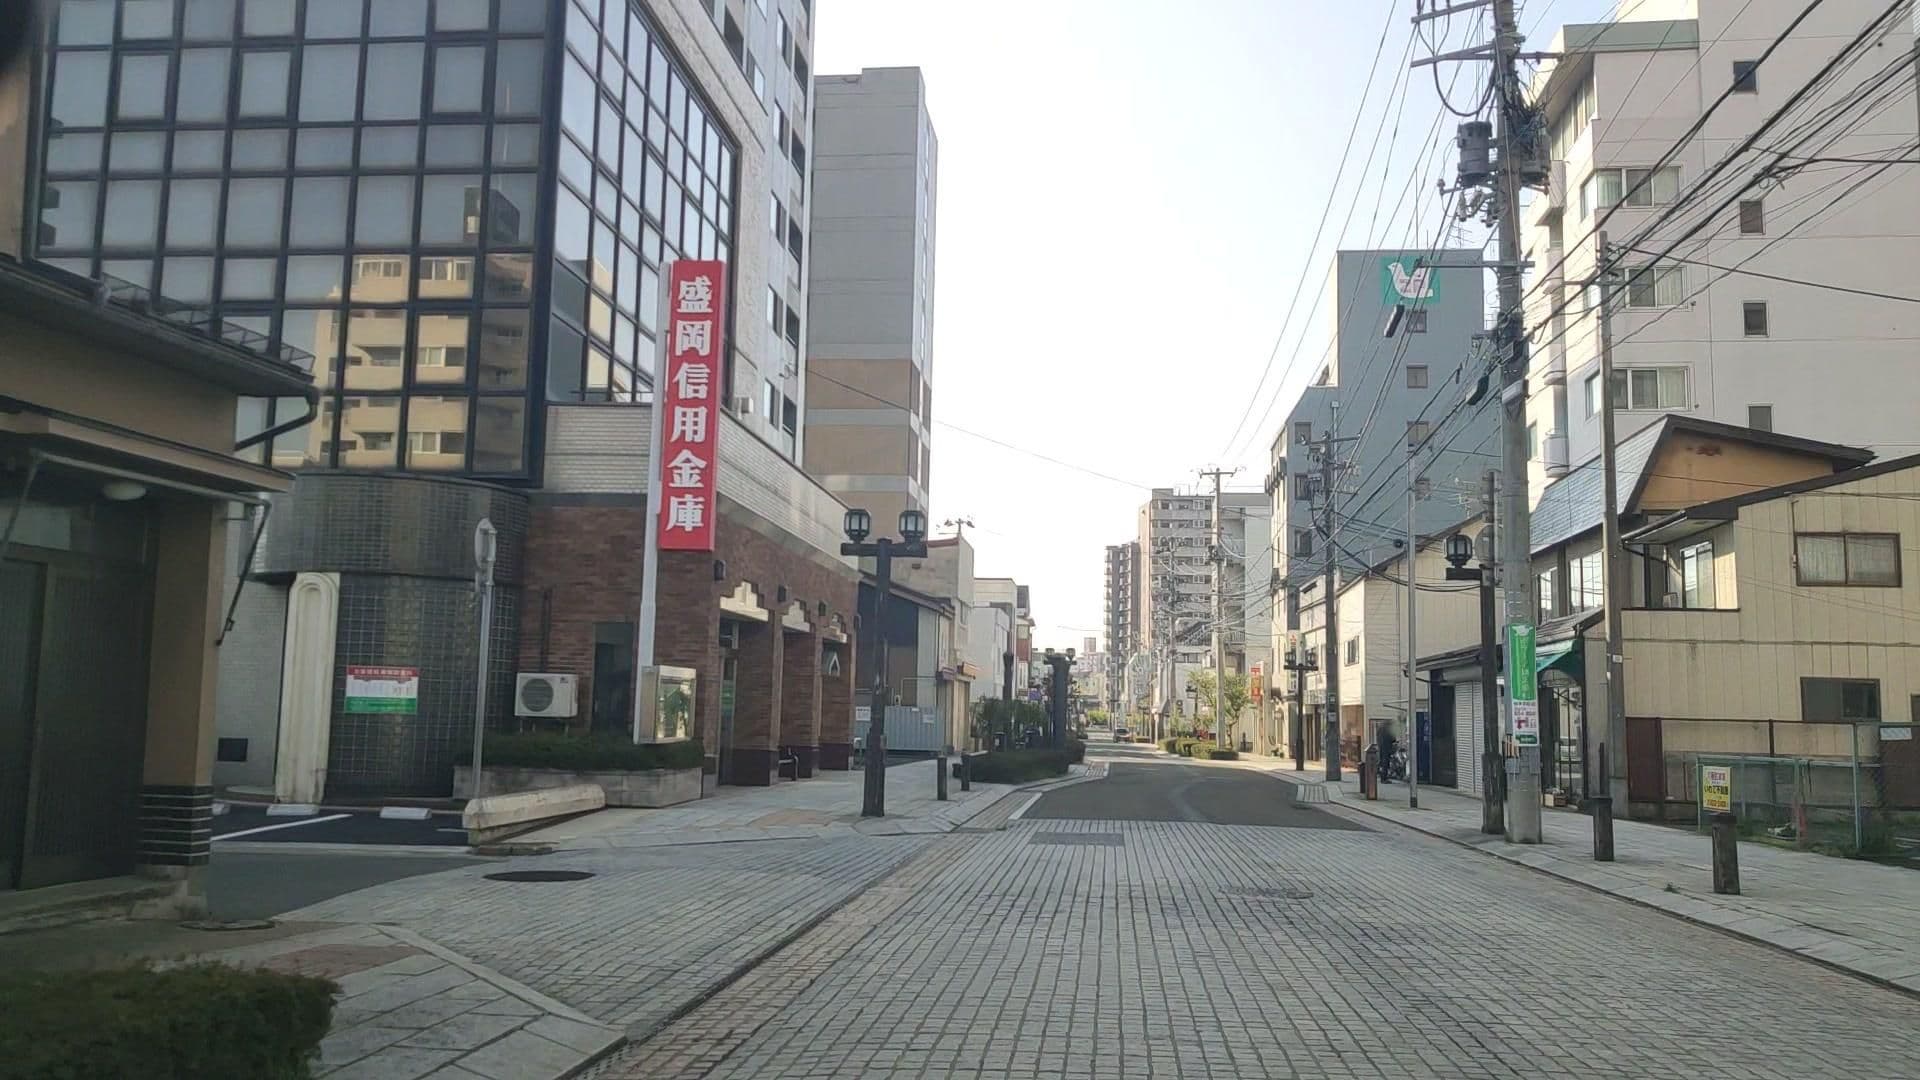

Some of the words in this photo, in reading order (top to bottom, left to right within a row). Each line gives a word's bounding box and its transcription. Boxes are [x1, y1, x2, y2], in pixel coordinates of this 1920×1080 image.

[665, 275, 714, 533] 盛岡信用金庫
